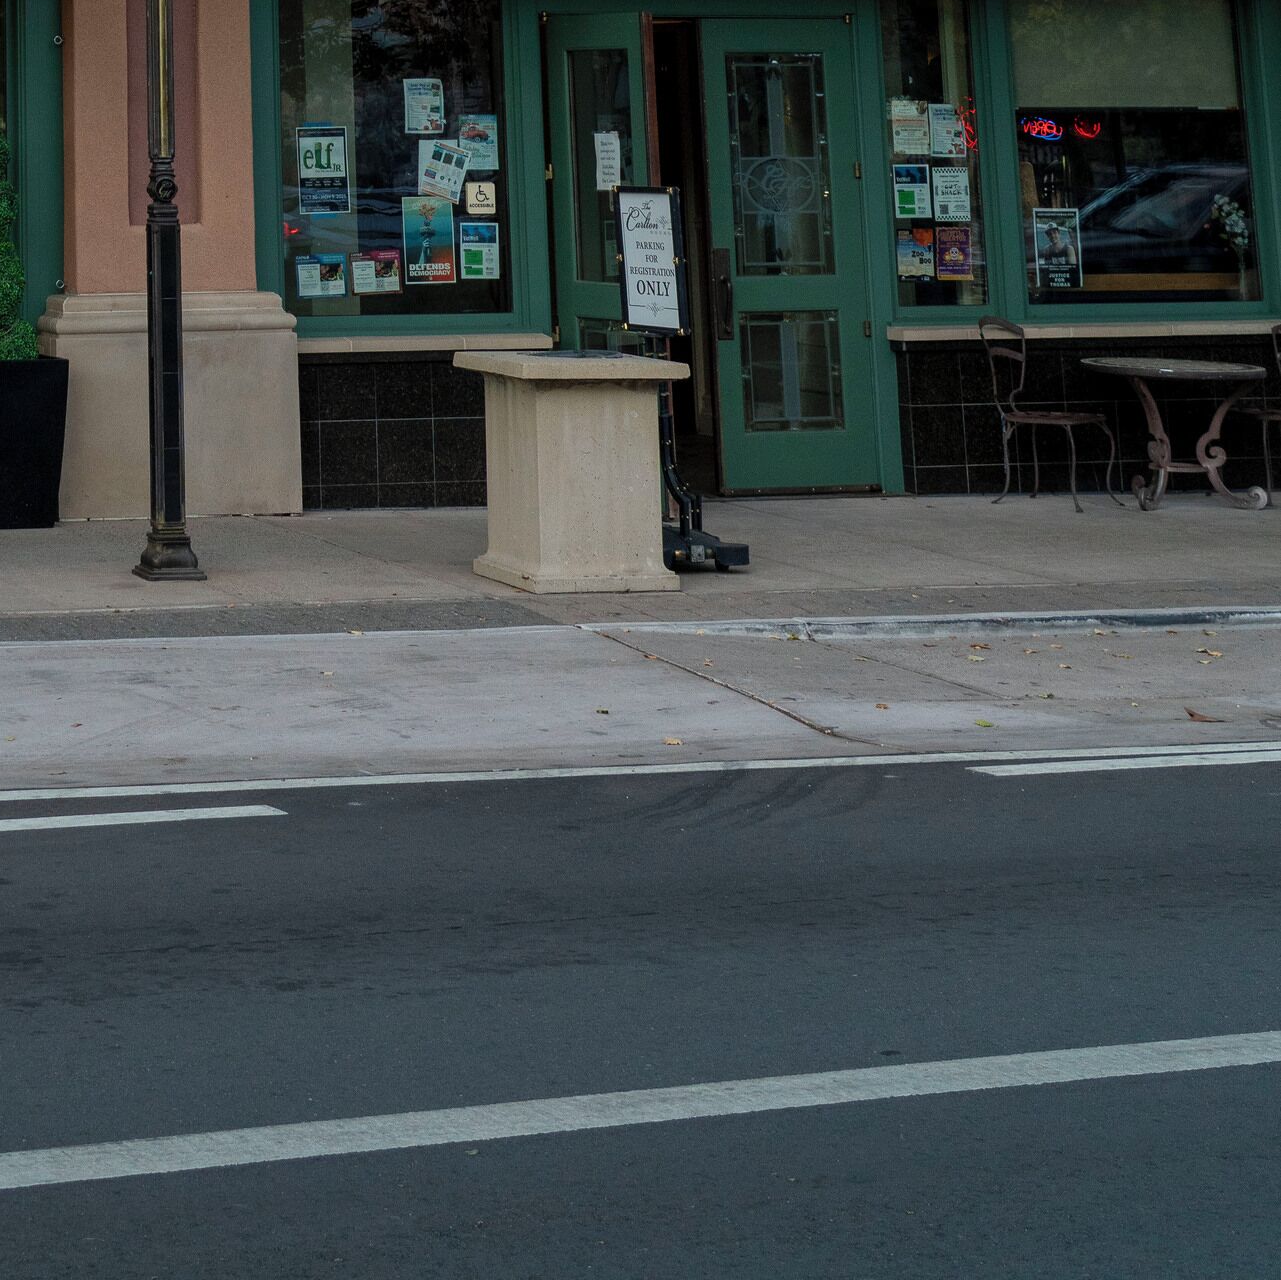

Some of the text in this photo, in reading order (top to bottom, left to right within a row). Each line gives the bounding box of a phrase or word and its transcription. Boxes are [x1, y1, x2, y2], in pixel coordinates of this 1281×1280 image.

[626, 206, 658, 232] Carlton
[636, 241, 665, 251] PARKING
[646, 254, 658, 263] FOR
[409, 263, 451, 271] DEFENDS
[630, 266, 675, 277] REGISTRATION
[637, 280, 671, 297] ONLY
